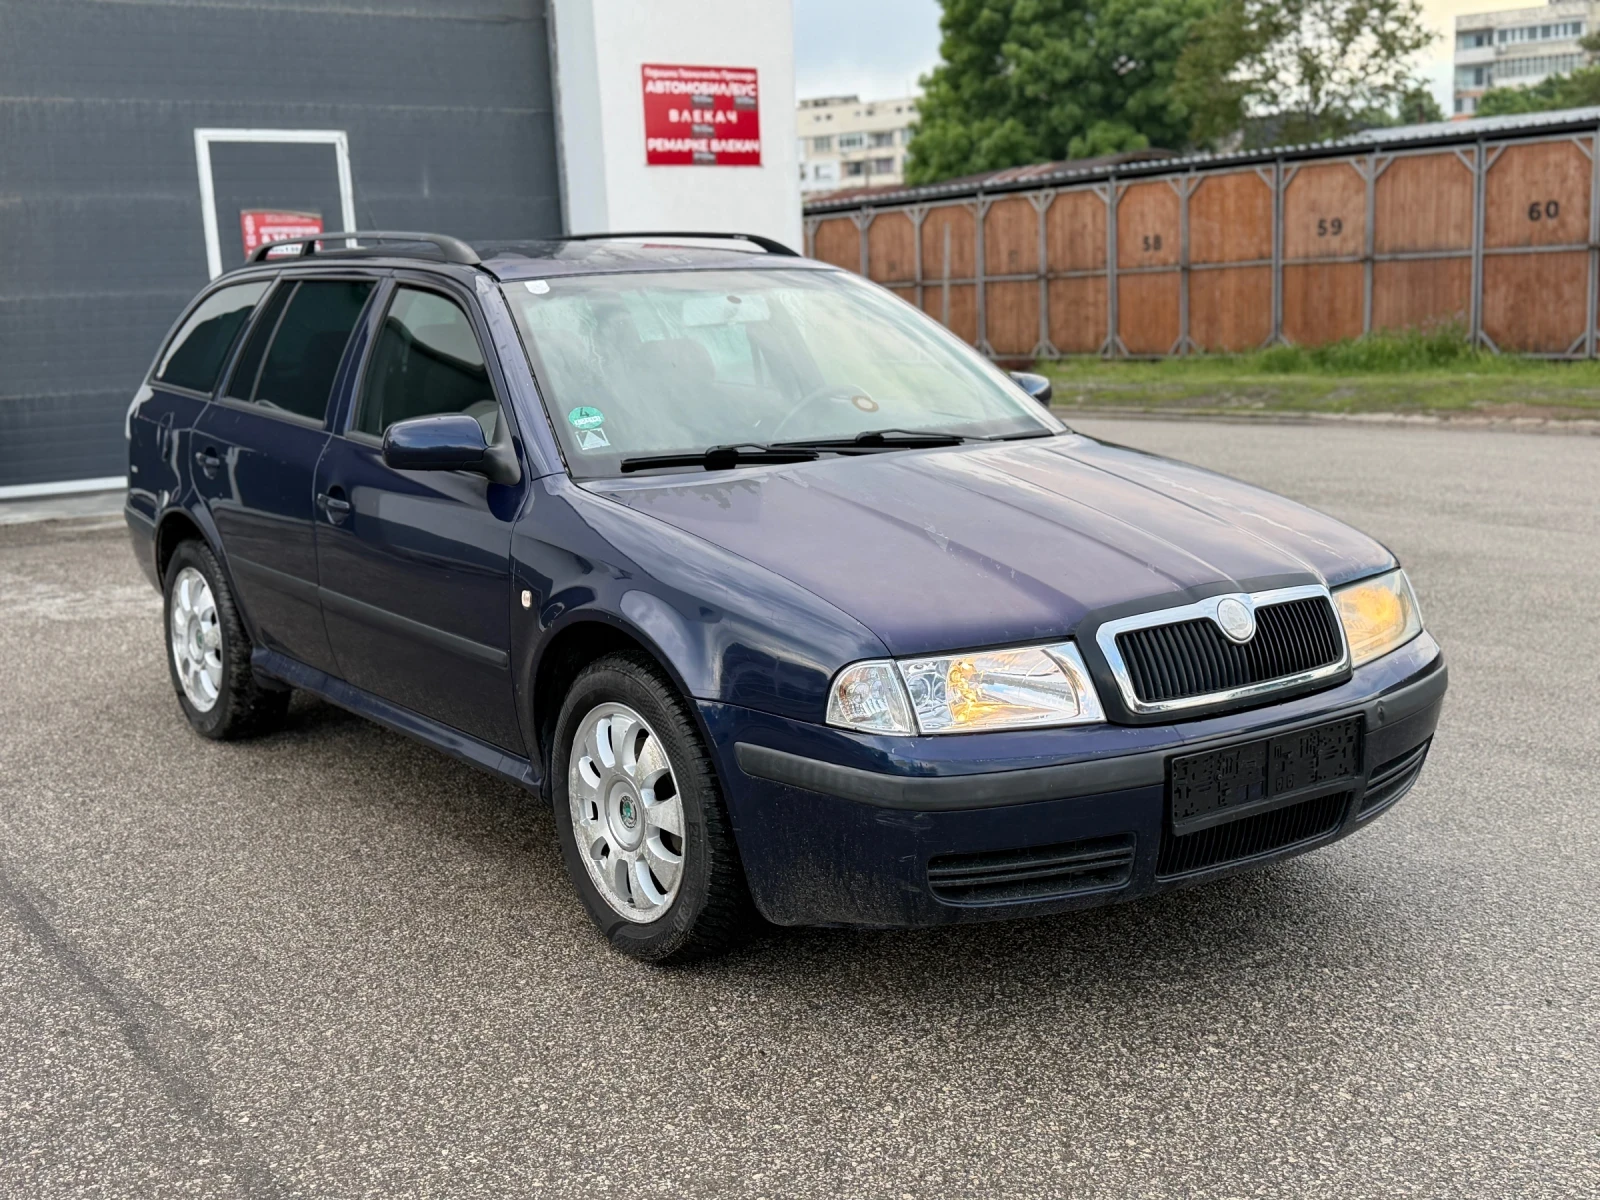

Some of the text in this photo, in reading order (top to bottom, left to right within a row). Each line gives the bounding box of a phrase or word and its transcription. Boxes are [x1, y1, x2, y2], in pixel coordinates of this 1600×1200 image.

[668, 108, 738, 124] ВЛЕКАЧ
[647, 138, 760, 153] РЕМАРКЕ ВЛЕКАЧ
[1528, 201, 1559, 221] 60
[1317, 217, 1343, 236] 59
[1143, 234, 1162, 252] 58
[580, 407, 590, 417] 4
